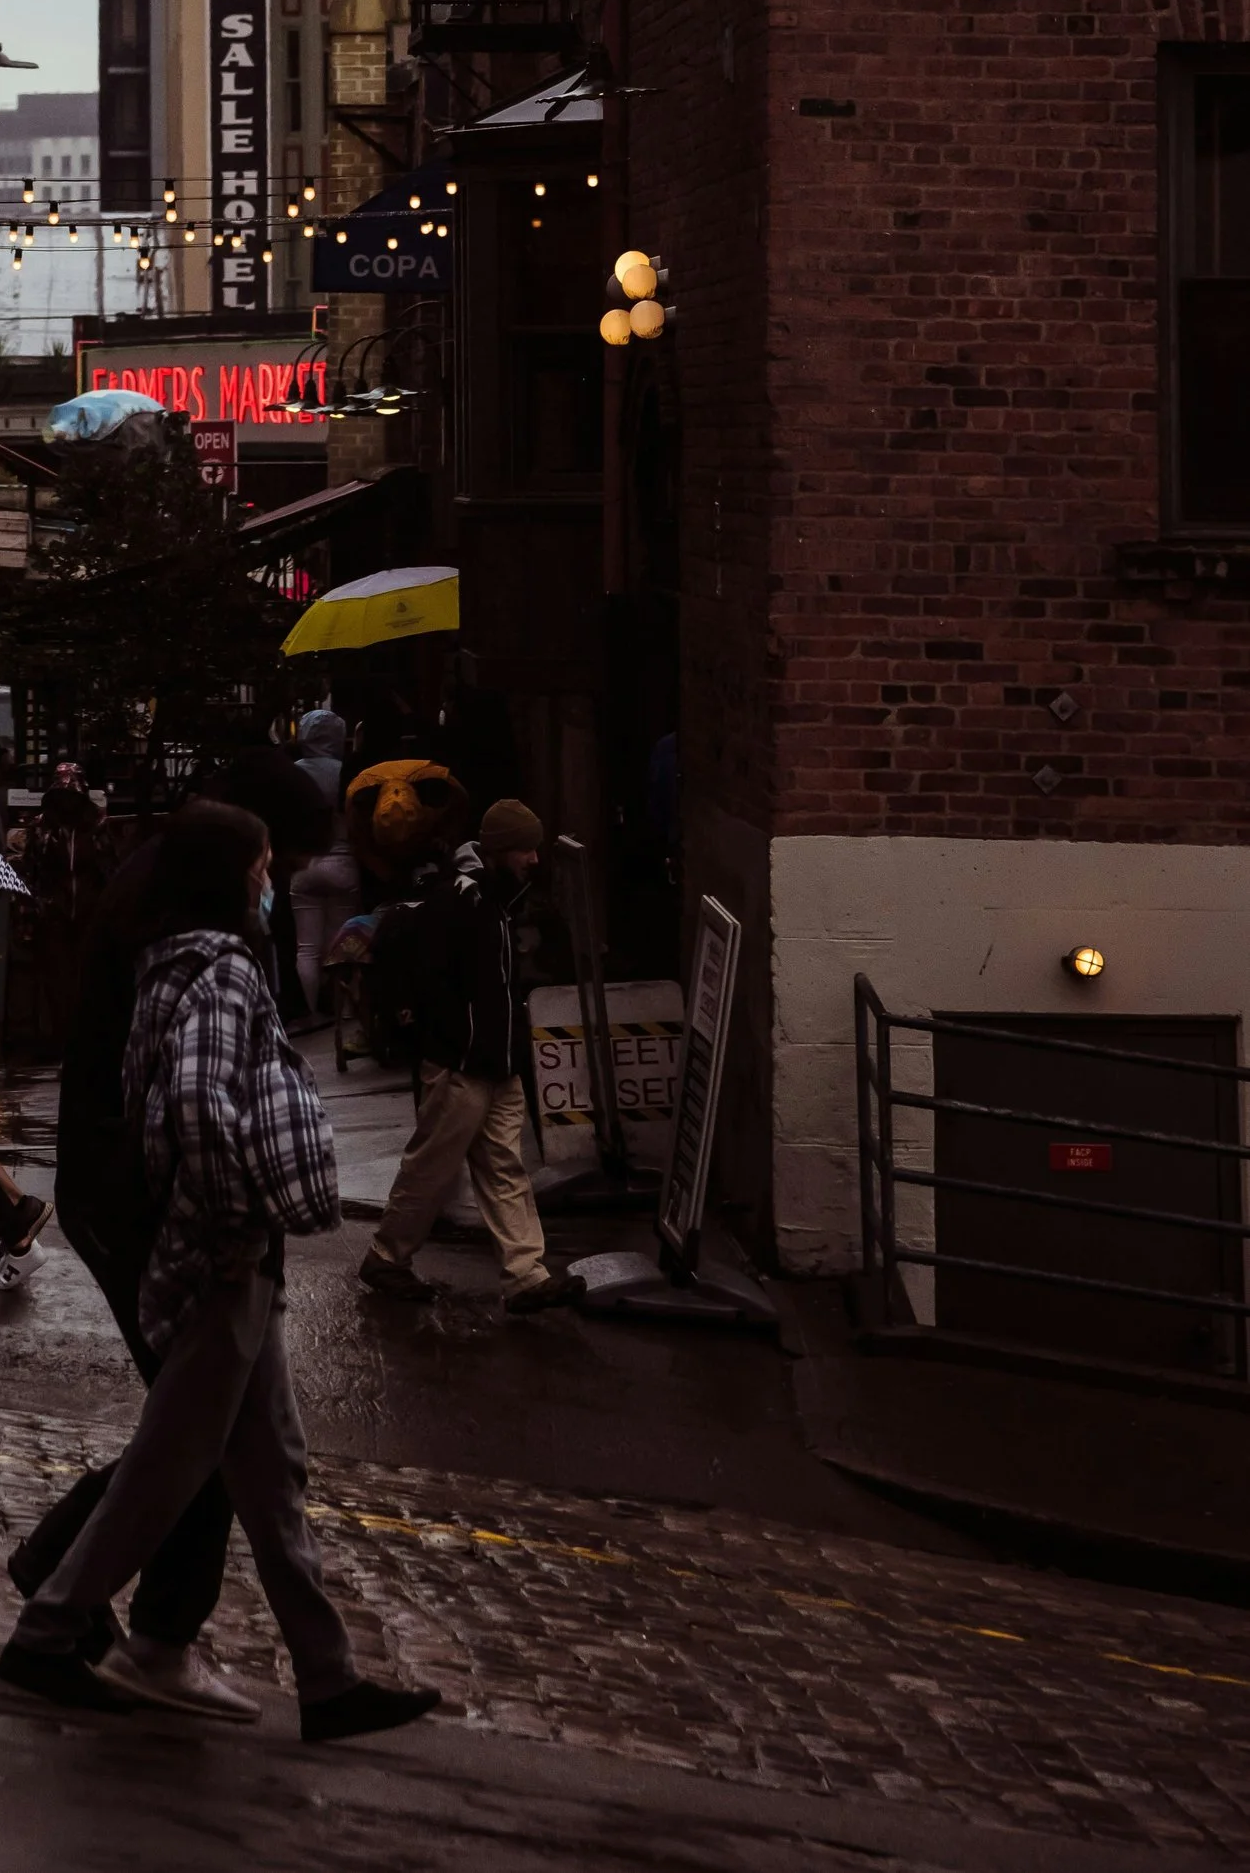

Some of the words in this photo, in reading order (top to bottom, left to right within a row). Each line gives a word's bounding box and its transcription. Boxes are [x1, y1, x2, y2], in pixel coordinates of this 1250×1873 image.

[219, 13, 256, 154] SALLE
[221, 170, 259, 311] HOTEL
[349, 253, 440, 279] COPA
[219, 361, 328, 425] MARKET
[194, 431, 230, 450] OPEN
[538, 1036, 681, 1070] STEET
[542, 1077, 678, 1110] CLSE
